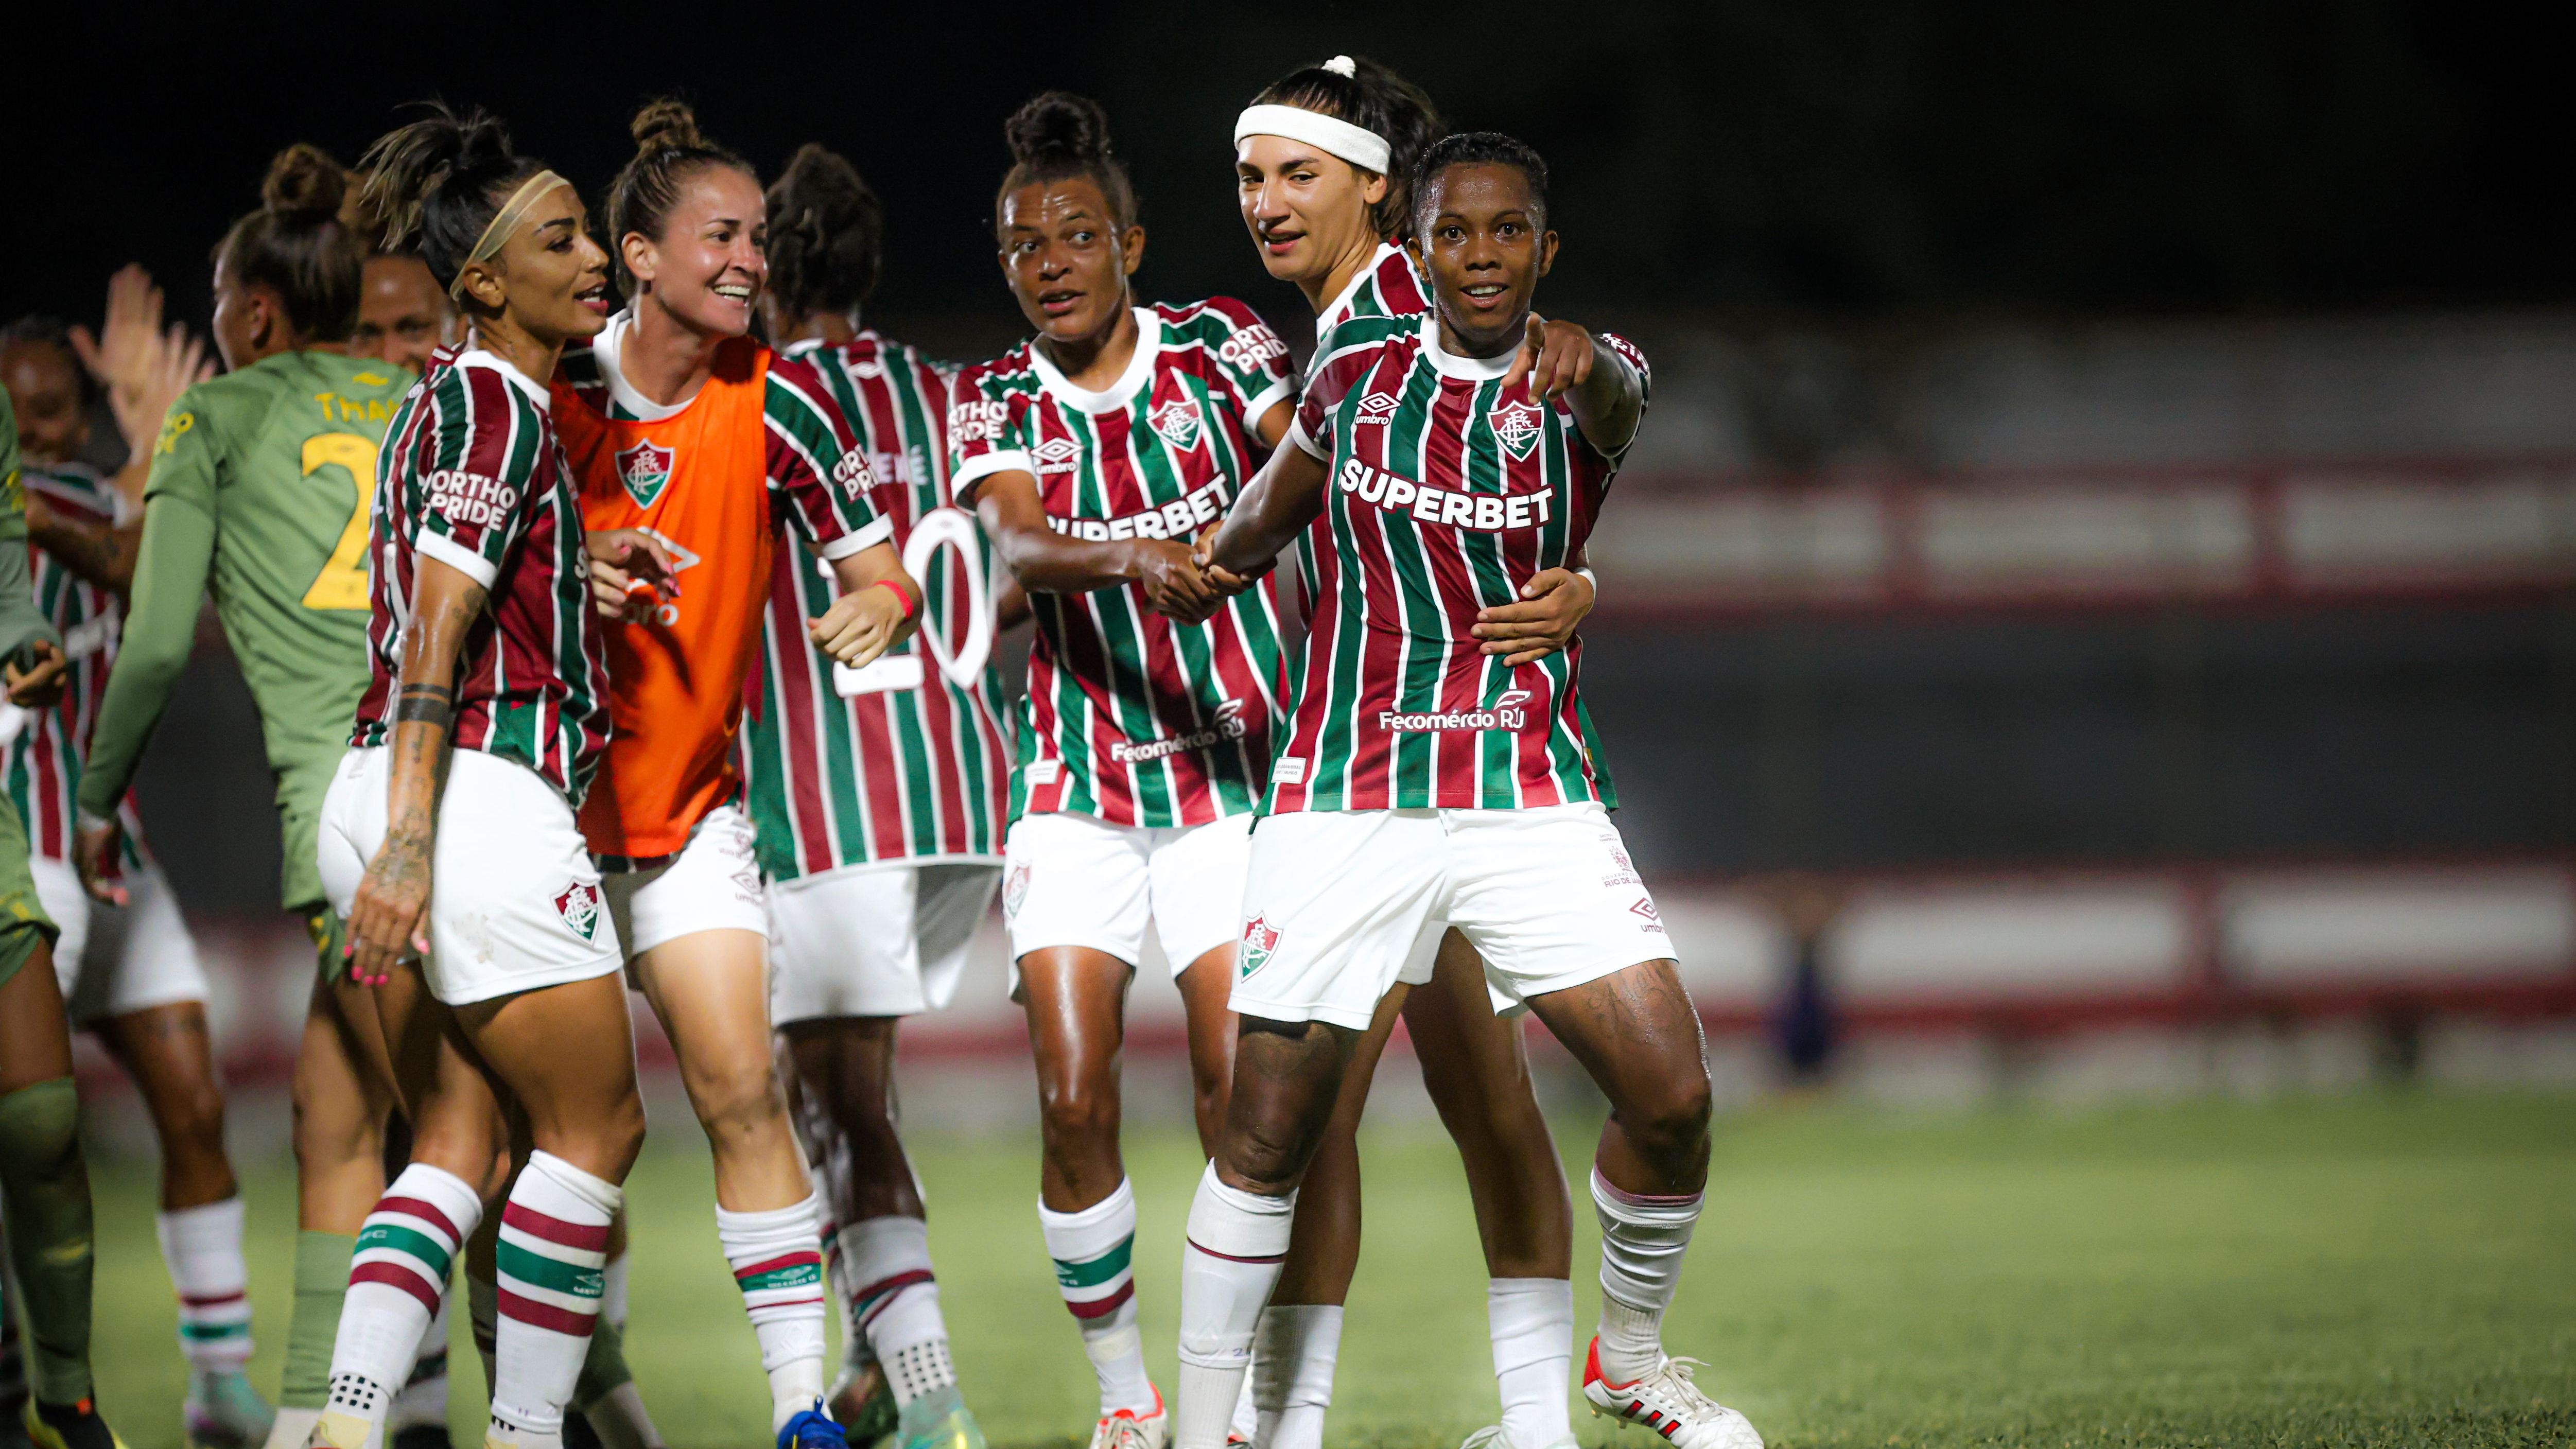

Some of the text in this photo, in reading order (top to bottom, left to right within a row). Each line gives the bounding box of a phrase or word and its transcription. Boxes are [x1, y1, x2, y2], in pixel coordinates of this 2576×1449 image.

[1355, 414, 1389, 425] umbro
[1036, 462, 1077, 475] umbro
[431, 470, 516, 509] ORTHO
[1339, 458, 1553, 529] SUPERBET
[430, 492, 507, 531] PRIDE
[1379, 706, 1524, 729] Fecomércio RJ
[1604, 878, 1620, 887] RIO
